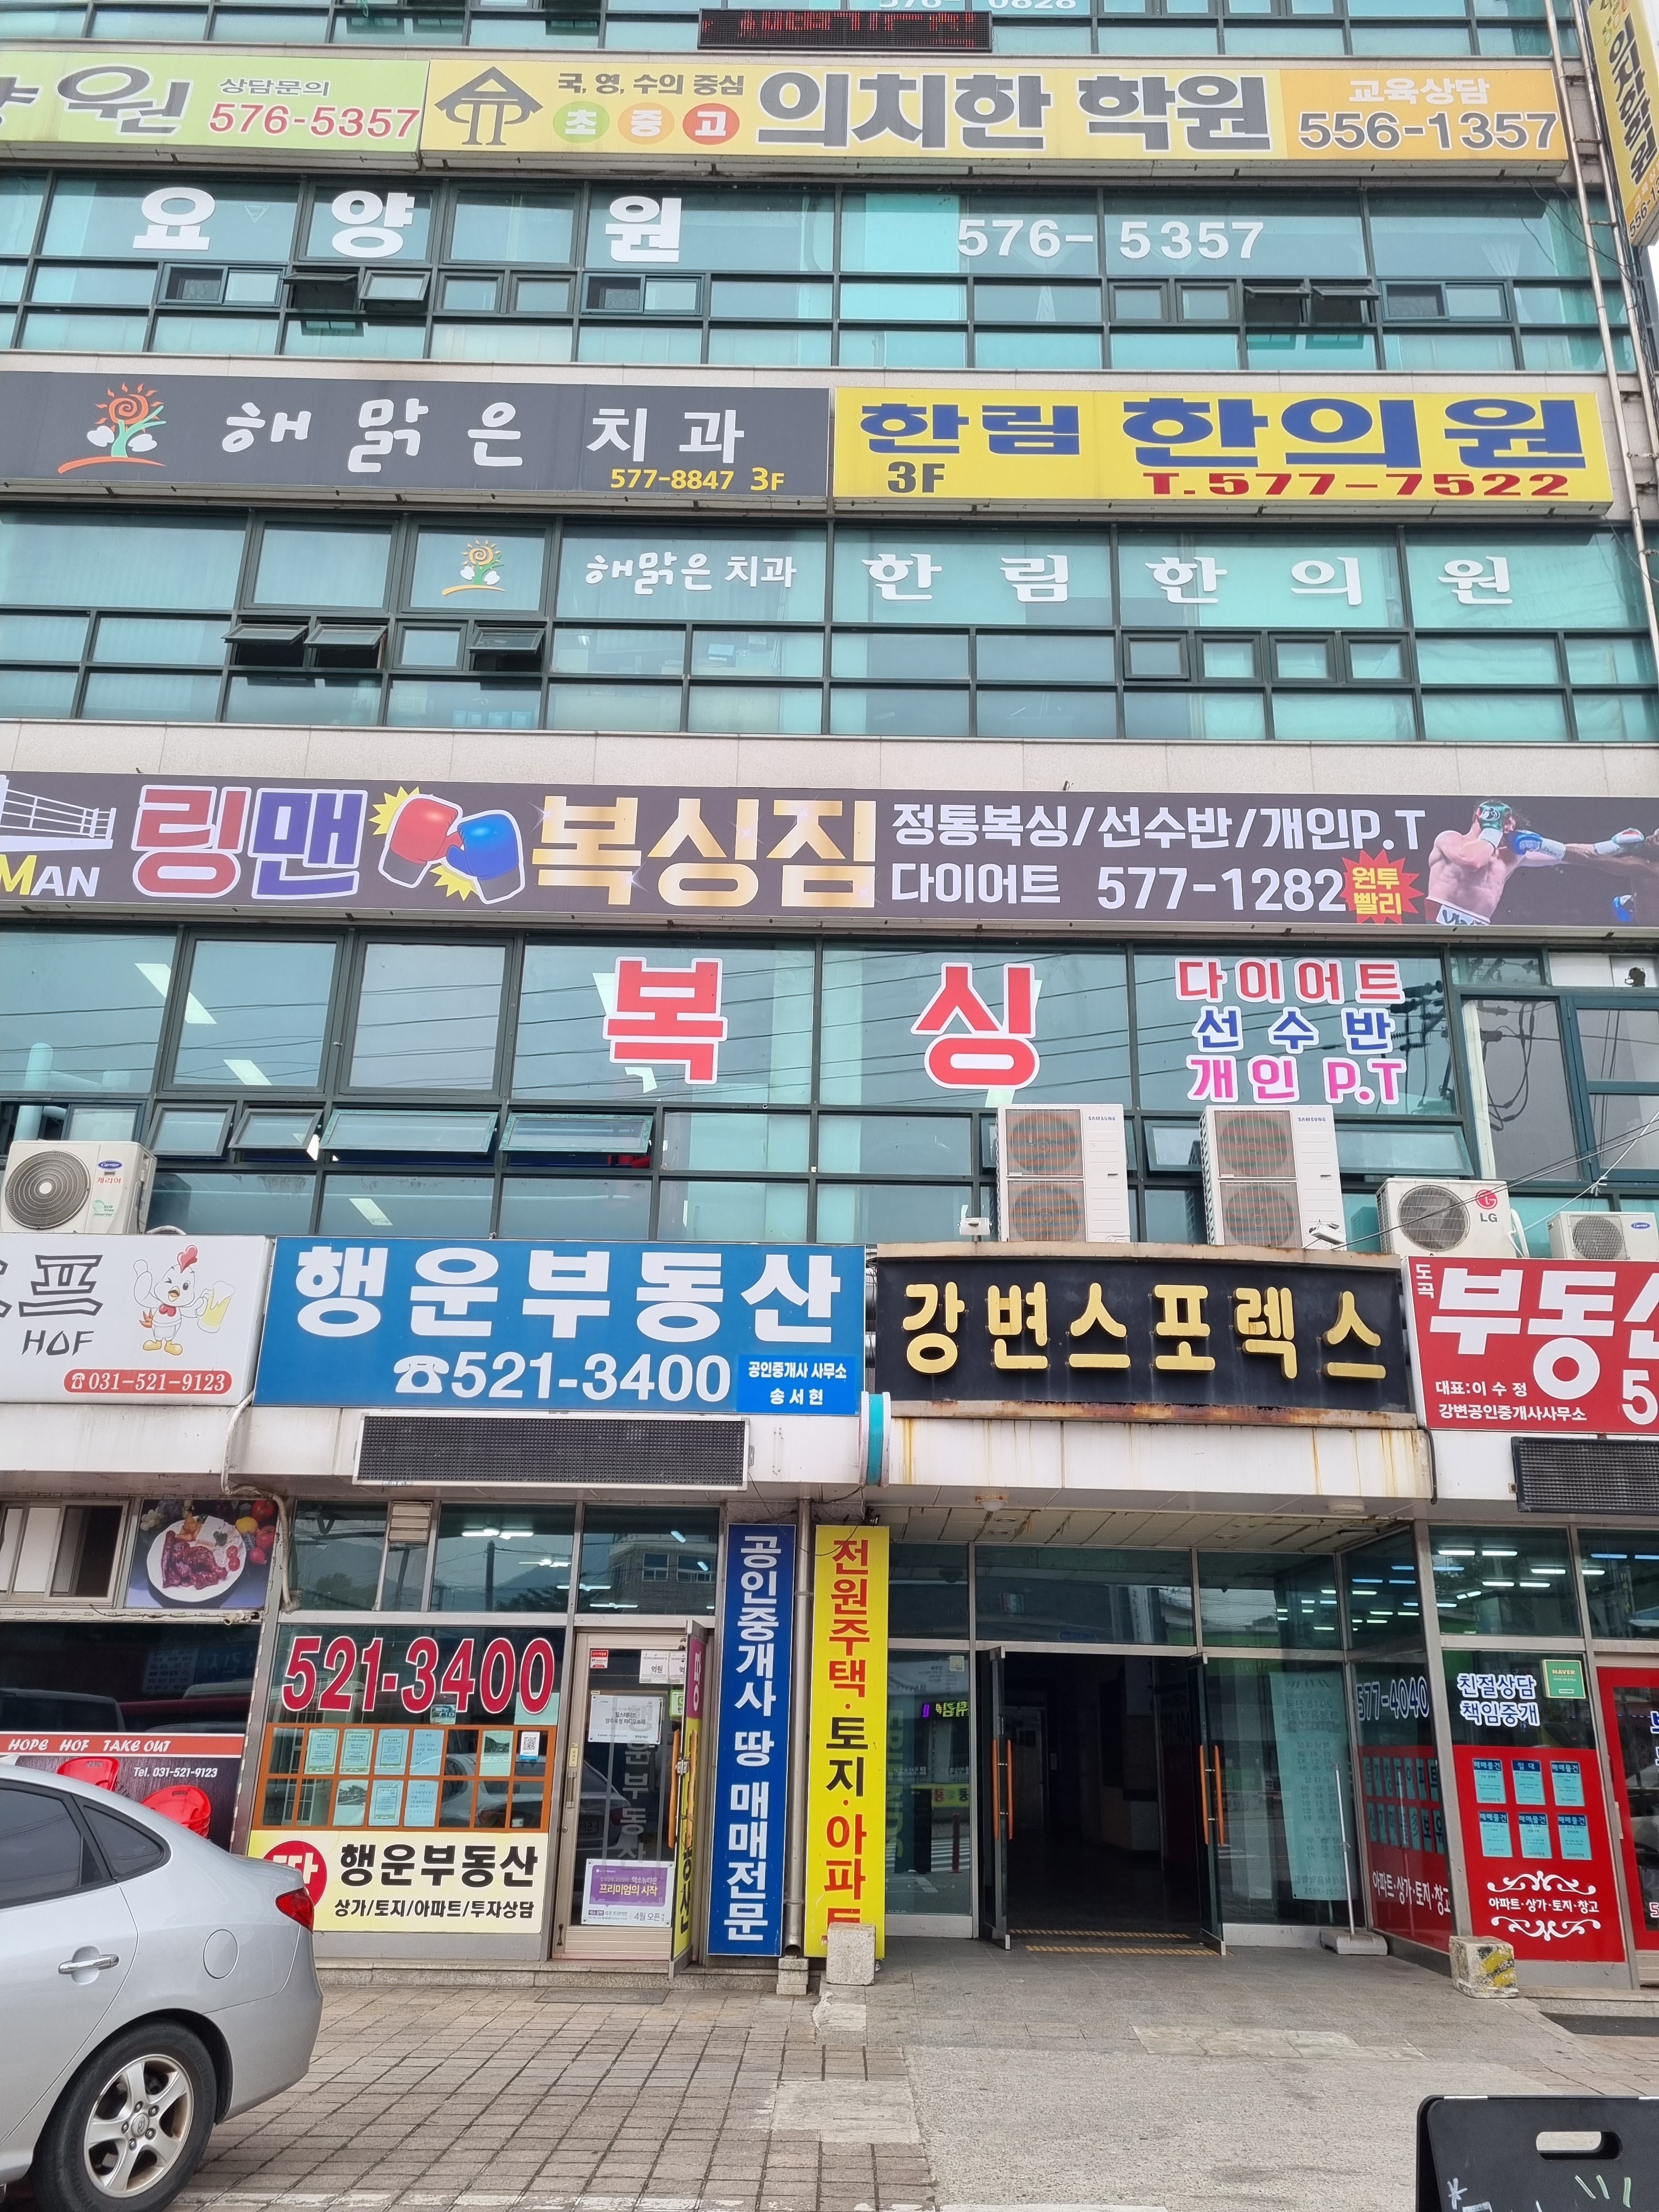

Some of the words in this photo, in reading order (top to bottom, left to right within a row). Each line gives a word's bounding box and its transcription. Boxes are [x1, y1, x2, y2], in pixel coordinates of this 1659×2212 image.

[219, 78, 330, 97] 상담문의
[633, 74, 684, 95] 수의
[693, 74, 745, 97] 중심
[1349, 78, 1490, 105] 교육상담
[208, 103, 421, 138] 576-5357
[565, 110, 597, 136] 초
[630, 110, 663, 138] 중
[695, 111, 727, 137] 고
[757, 71, 1053, 151] 의치한
[1076, 73, 1273, 153] 학원
[1297, 111, 1560, 150] 556-1357
[860, 403, 1080, 456] 한림
[1122, 397, 1587, 469] 한의원
[611, 469, 735, 491] 577-8847
[751, 467, 785, 491] 3F
[887, 461, 946, 494] 3F
[586, 551, 712, 596] 해맑은
[724, 555, 797, 589] 치과
[532, 795, 877, 909] 복싱짐
[891, 863, 1060, 905] 다이어트
[1098, 866, 1347, 912] 577-1282
[1352, 866, 1400, 889] 원투
[1353, 891, 1402, 916] 빨리
[1323, 1057, 1407, 1105] P.T
[1480, 1213, 1498, 1223] LG
[0, 1254, 104, 1318] 프
[296, 1246, 842, 1343] 행운부동산
[1415, 1263, 1435, 1299] 도곡
[21, 1329, 94, 1356] HOF
[88, 1371, 226, 1392] 031-521-9123
[451, 1351, 731, 1402] 521-3400
[748, 1361, 808, 1379] 공인중개사
[810, 1361, 847, 1379] 사무소
[1438, 1403, 1588, 1422] 강변공인중개사사무소
[734, 1536, 782, 1717] 공인중개사
[281, 1635, 555, 1714] 521-3400
[1457, 1673, 1537, 1700] 친절상담
[1356, 1675, 1430, 1722] 577-4040
[1460, 1701, 1541, 1727] 책임중개
[8, 1738, 49, 1752] HOPE
[59, 1739, 90, 1752] HOF
[103, 1739, 142, 1752] TAKE
[144, 1740, 171, 1753] OUT
[734, 1730, 775, 1767] 땅
[133, 1766, 150, 1778] Tel.
[153, 1767, 218, 1778] 031-521-9123
[340, 1843, 538, 1888] 행운부동산
[724, 1781, 770, 1941] 매매전문
[599, 1884, 640, 1895] 프리미엄의
[641, 1885, 658, 1896] 시작
[335, 1898, 534, 1918] 상가/토지/아파트/투자상담
[634, 1912, 646, 1921] 4월
[647, 1912, 661, 1921] 오픈
